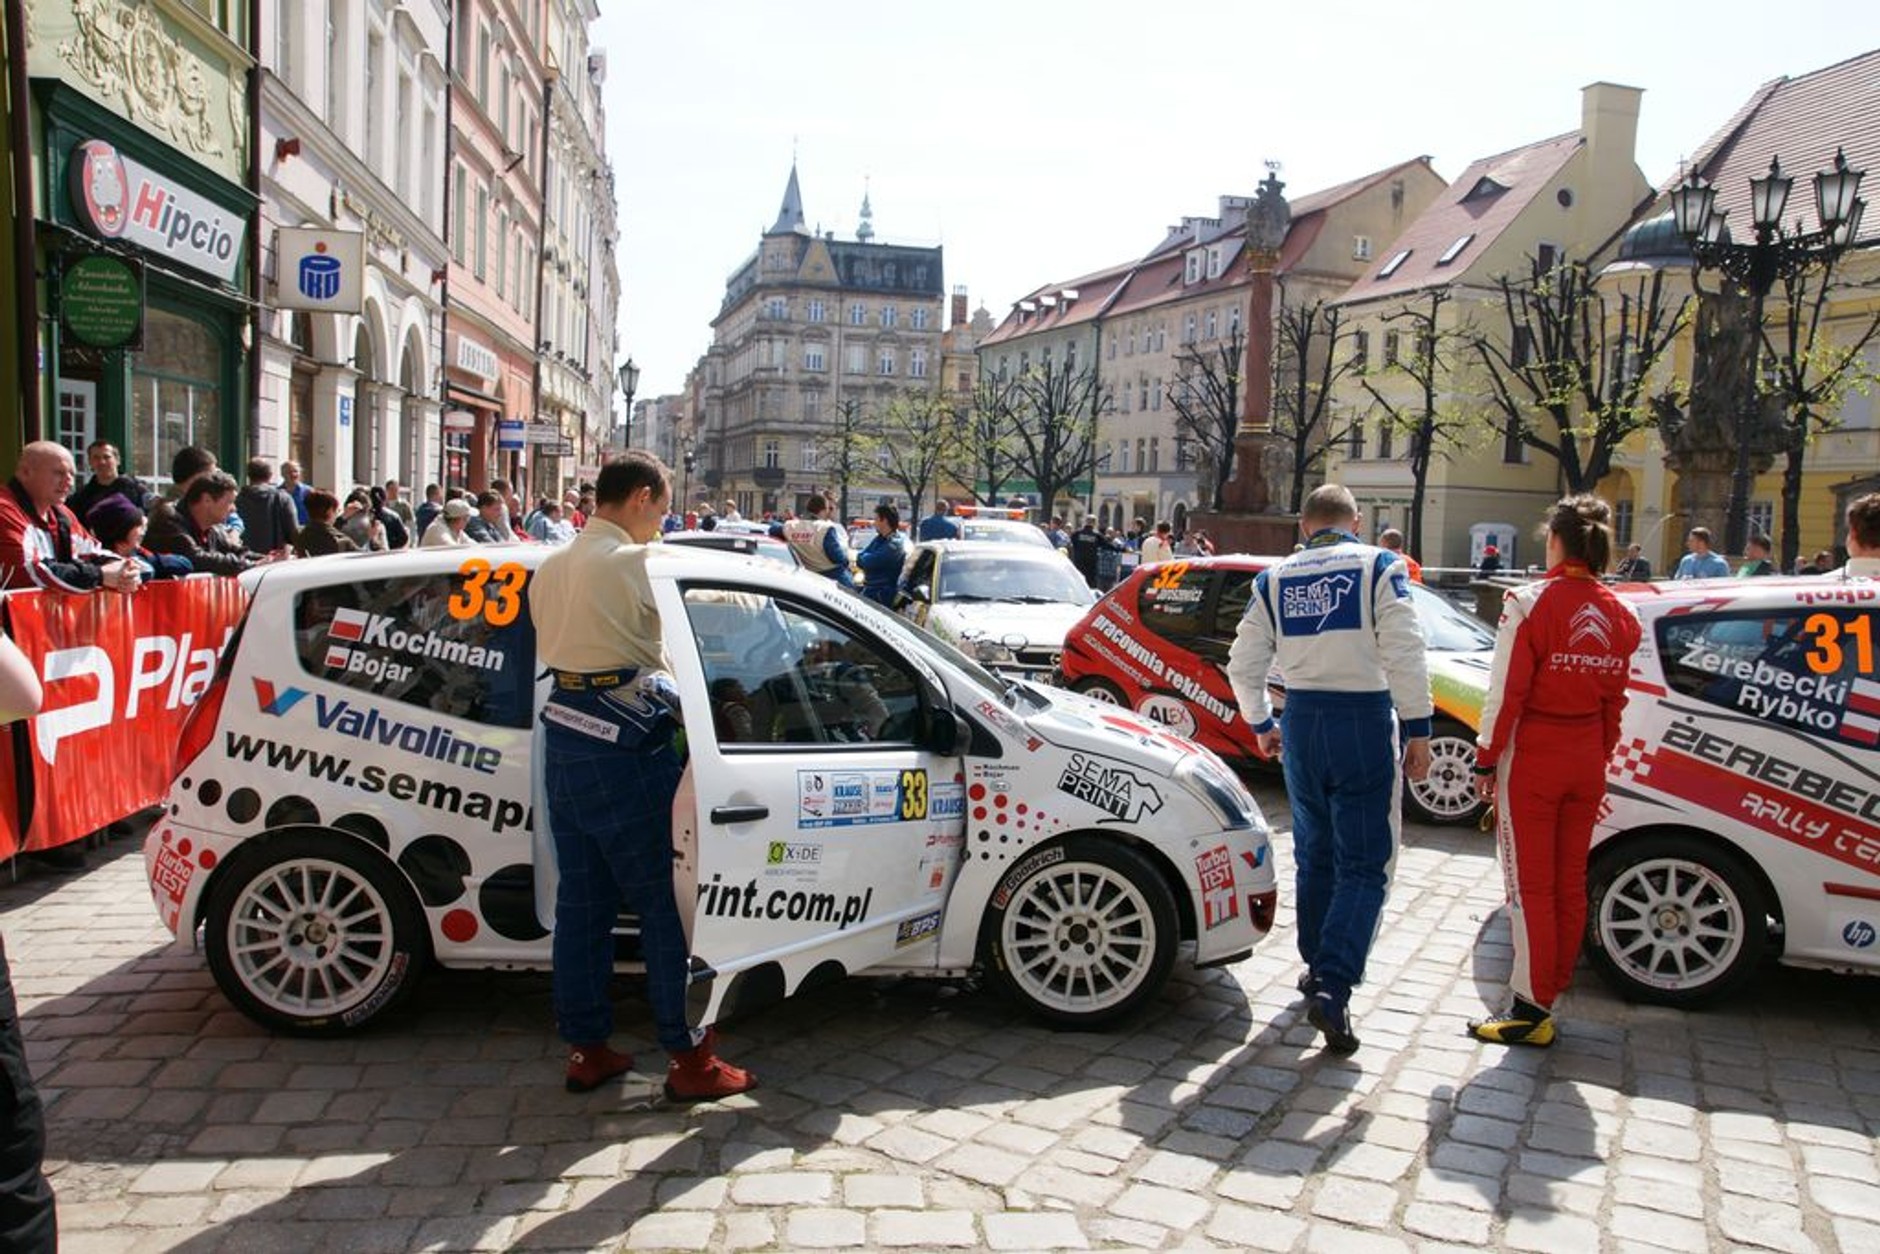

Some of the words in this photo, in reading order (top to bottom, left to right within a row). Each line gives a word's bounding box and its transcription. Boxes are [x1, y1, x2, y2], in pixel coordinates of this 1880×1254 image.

[132, 180, 233, 261] Hipcio
[448, 558, 526, 627] 33
[1153, 563, 1189, 590] 32
[1283, 583, 1332, 601] SEMA
[1284, 600, 1333, 618] PRINT
[348, 649, 414, 683] Bojar
[364, 614, 505, 671] Kochman
[1804, 613, 1874, 675] 31
[1091, 613, 1165, 677] pracownia
[1164, 666, 1236, 725] reklamy
[1679, 637, 1848, 705] Żerebecki
[1737, 686, 1837, 730] Rybko
[316, 694, 502, 774] Valvoline
[902, 770, 928, 820] 33
[1058, 771, 1130, 819] PRINT
[1067, 752, 1132, 800] SEMA
[1740, 791, 1831, 840] RALLY
[1201, 862, 1232, 892] TEST
[1848, 922, 1871, 947] hp
